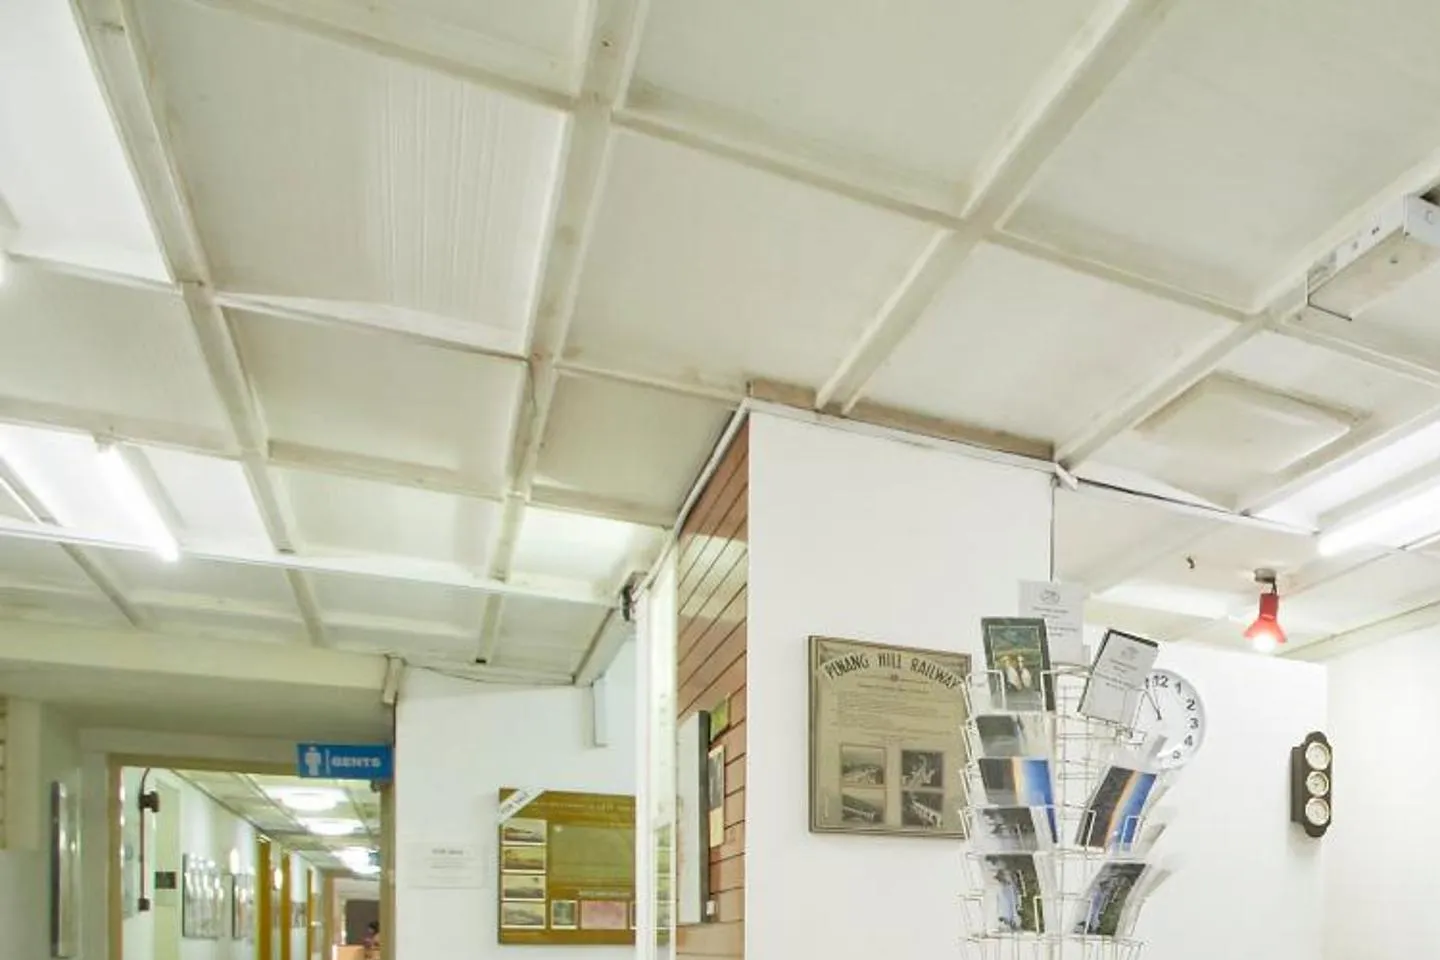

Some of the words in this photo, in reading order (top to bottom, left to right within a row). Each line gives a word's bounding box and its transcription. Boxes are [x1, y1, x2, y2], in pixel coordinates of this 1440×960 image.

[824, 654, 869, 679] PENANG
[878, 653, 901, 669] HILL
[910, 657, 961, 689] RAILWAY
[1186, 699, 1196, 711] 2
[1190, 717, 1199, 729] 3
[332, 756, 381, 767] GENTS
